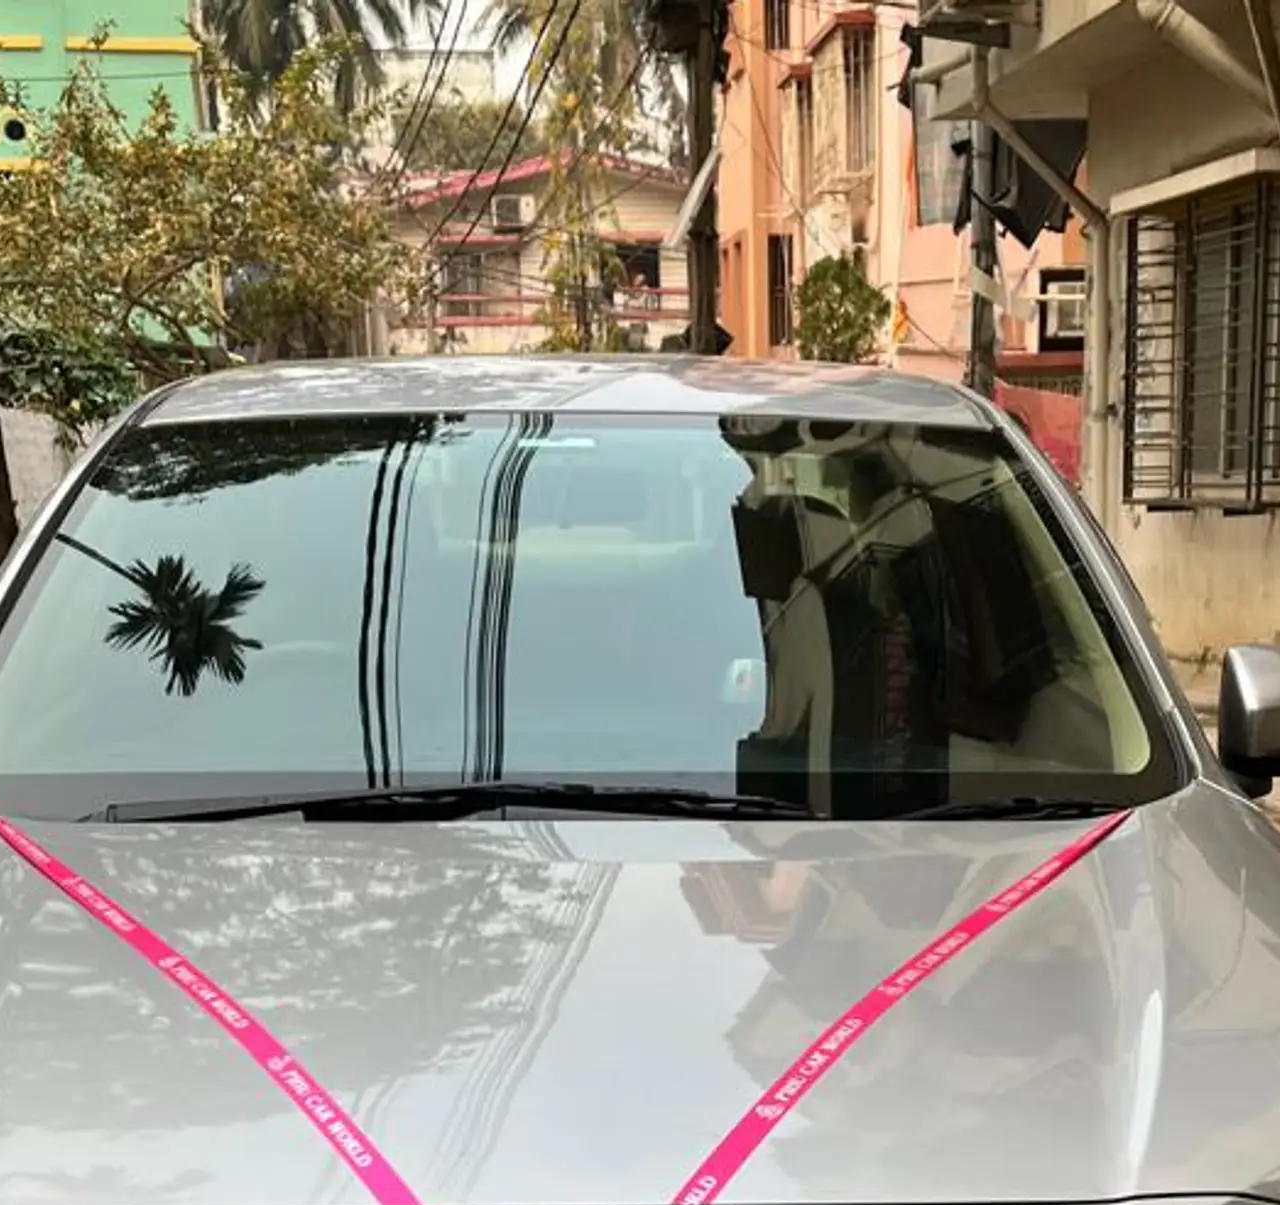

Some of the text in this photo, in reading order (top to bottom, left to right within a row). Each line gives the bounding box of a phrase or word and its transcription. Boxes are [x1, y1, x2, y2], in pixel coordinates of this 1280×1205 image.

[799, 1051, 830, 1075] CAR
[820, 1017, 864, 1051] WORLD
[304, 1094, 336, 1123] CAR
[327, 1121, 373, 1168] WORLD
